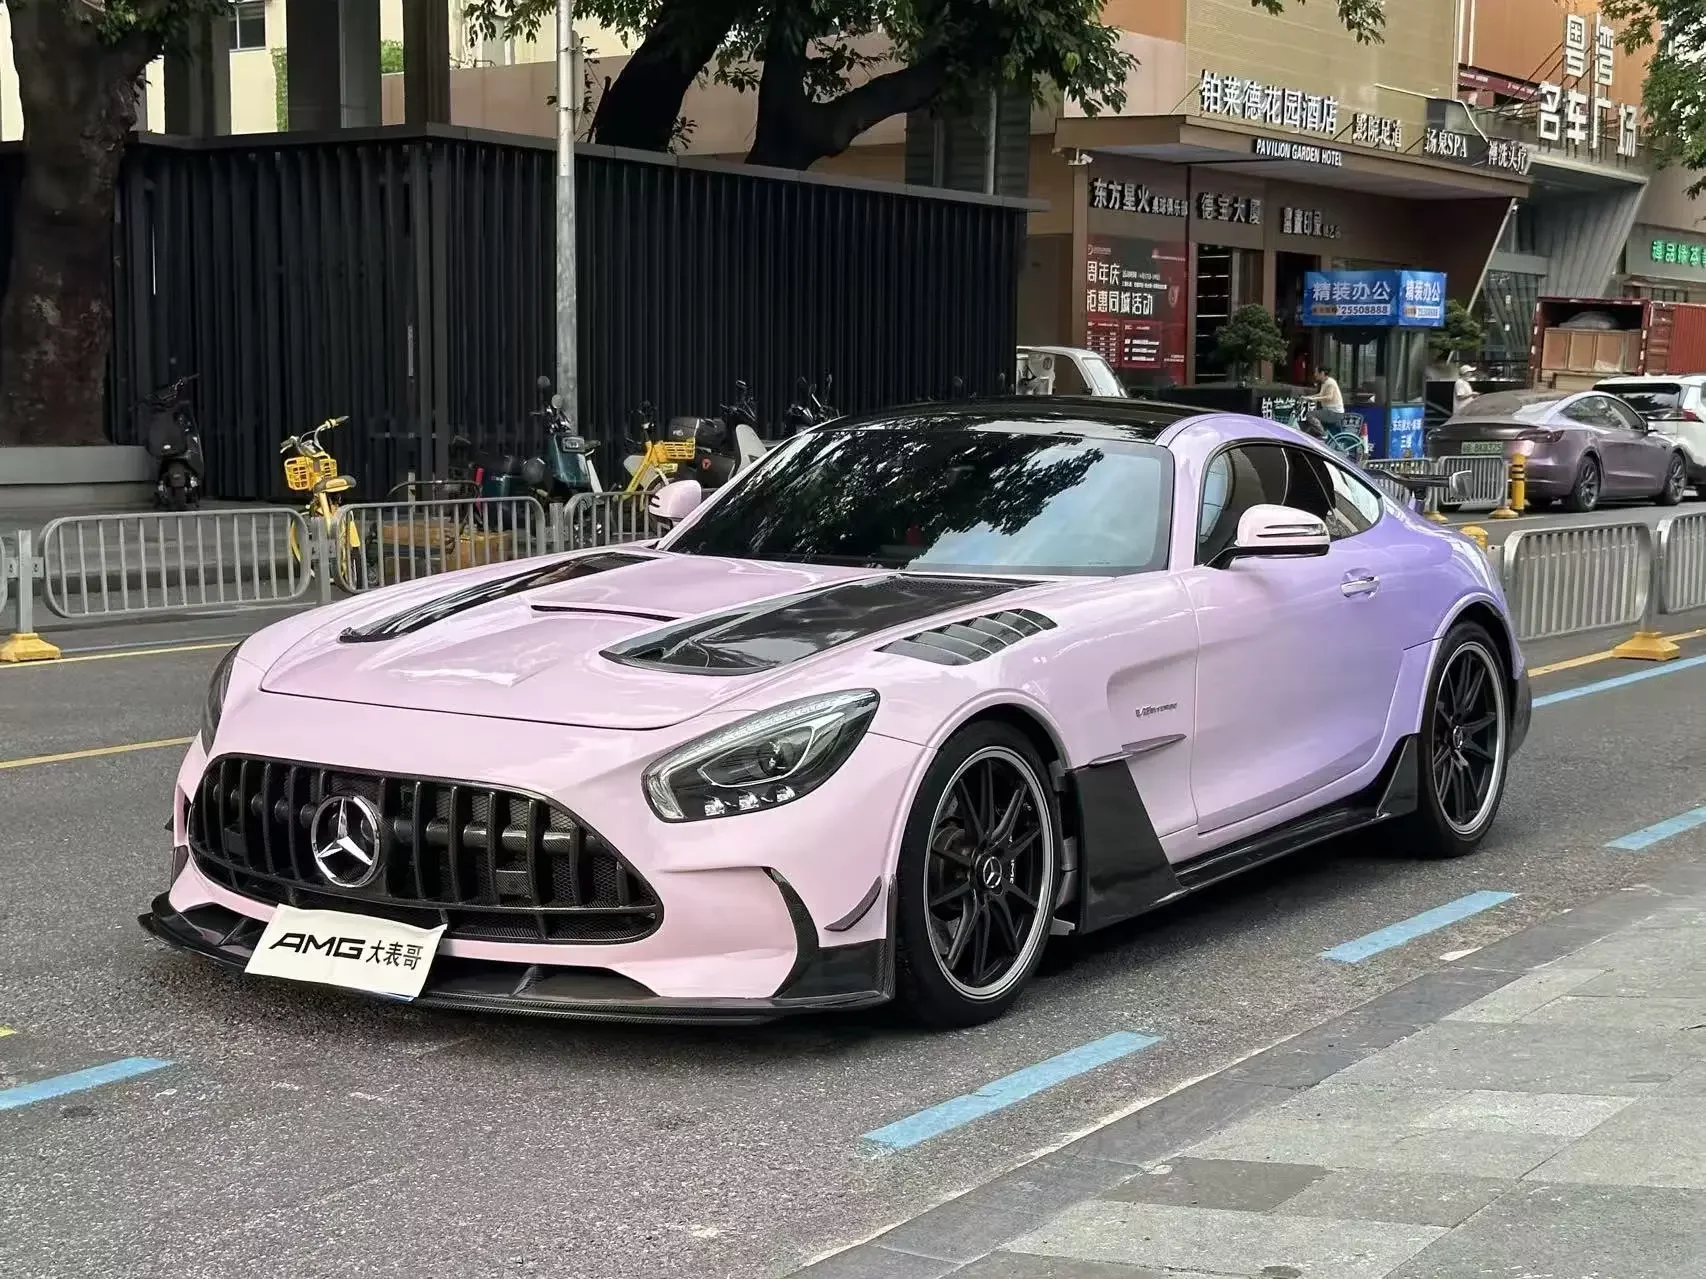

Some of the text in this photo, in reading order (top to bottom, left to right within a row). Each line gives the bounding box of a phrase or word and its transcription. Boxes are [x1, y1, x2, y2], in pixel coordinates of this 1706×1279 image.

[1566, 12, 1614, 86] 粤湾
[1200, 70, 1338, 134] 铂莱德花园酒店
[1353, 113, 1402, 148] 影院足道
[1539, 81, 1636, 158] 名车广场
[1256, 139, 1343, 166] PAVILION GARDEN HOTEL
[1426, 127, 1468, 158] 汤泉SPA
[1093, 178, 1150, 213] 东方星火
[1201, 192, 1261, 225] 德宝大厦
[1087, 261, 1120, 285] 周年庆
[1312, 281, 1391, 301] 精装办公
[1405, 280, 1440, 301] 精装办公
[269, 932, 424, 970] AMG 大表哥
